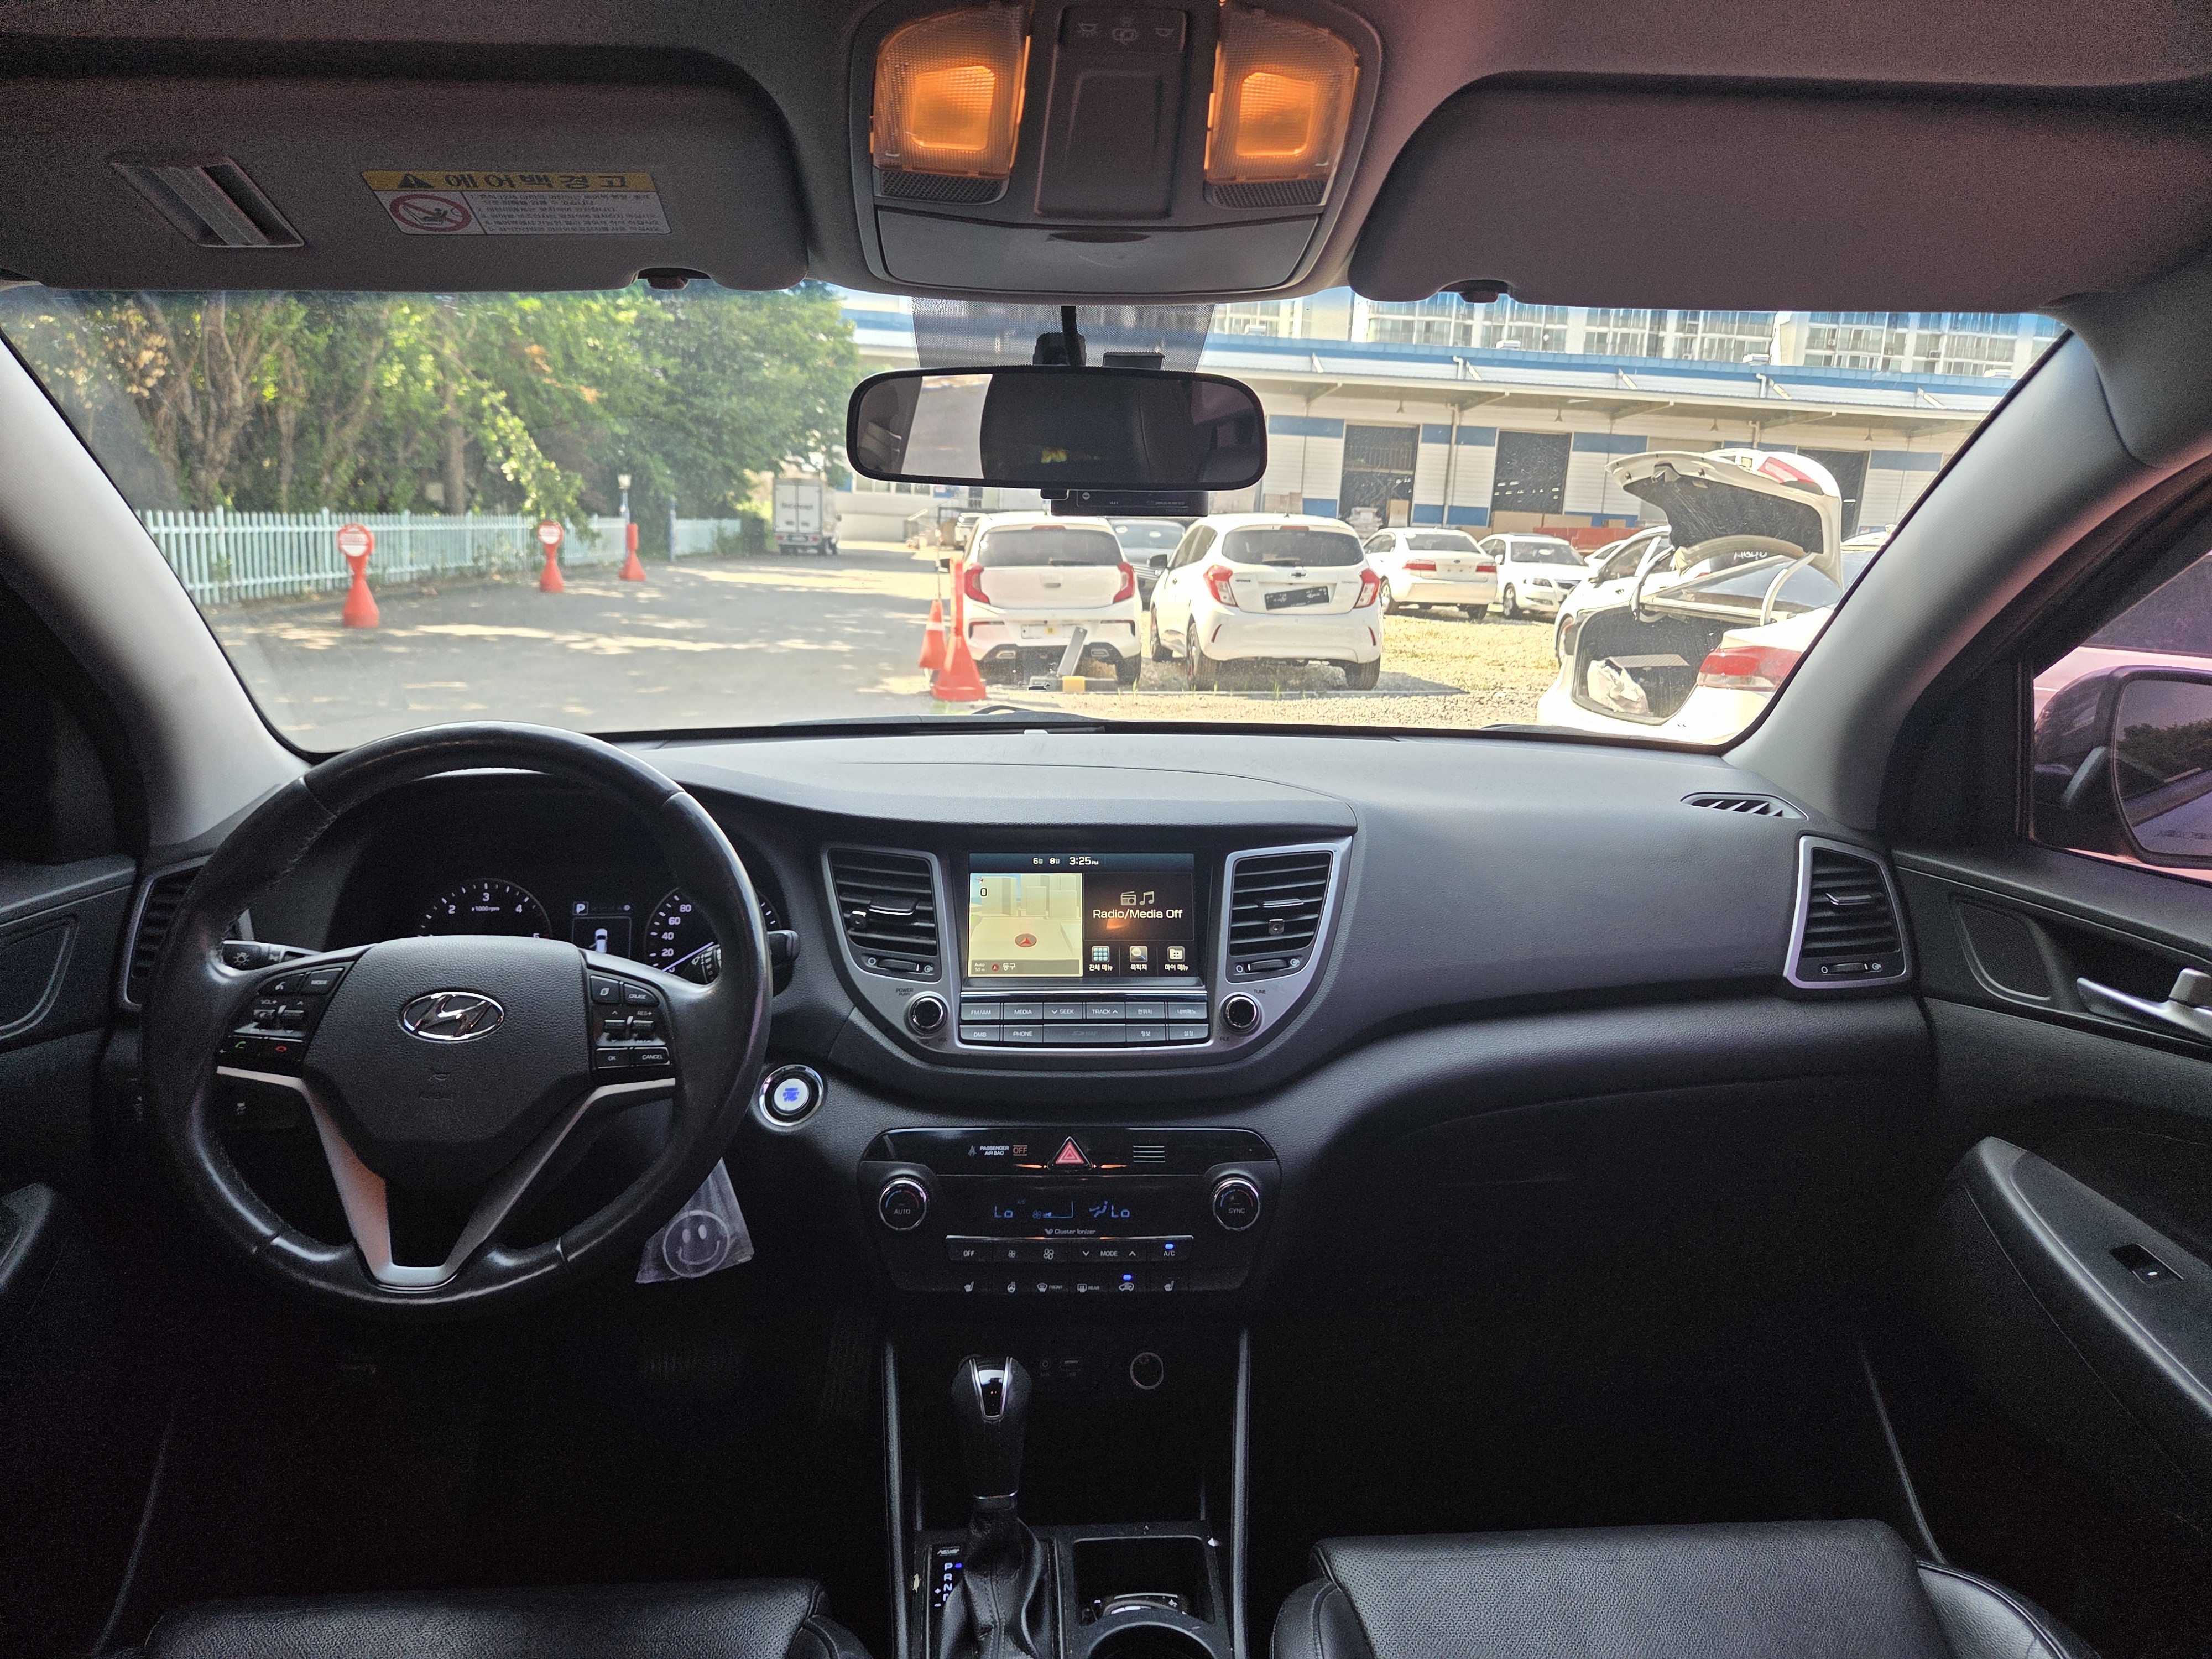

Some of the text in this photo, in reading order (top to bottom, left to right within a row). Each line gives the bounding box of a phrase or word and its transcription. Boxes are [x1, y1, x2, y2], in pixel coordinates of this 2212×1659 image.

[482, 892, 490, 902] 3
[448, 905, 456, 914] 2
[515, 904, 523, 914] 4
[576, 903, 585, 914] P
[679, 904, 691, 912] 80
[1093, 909, 1183, 919] Radio/Media Off
[668, 916, 680, 925] 60
[661, 932, 674, 940] 40
[661, 948, 674, 957] 20
[944, 1562, 953, 1571] P
[943, 1583, 953, 1592] N
